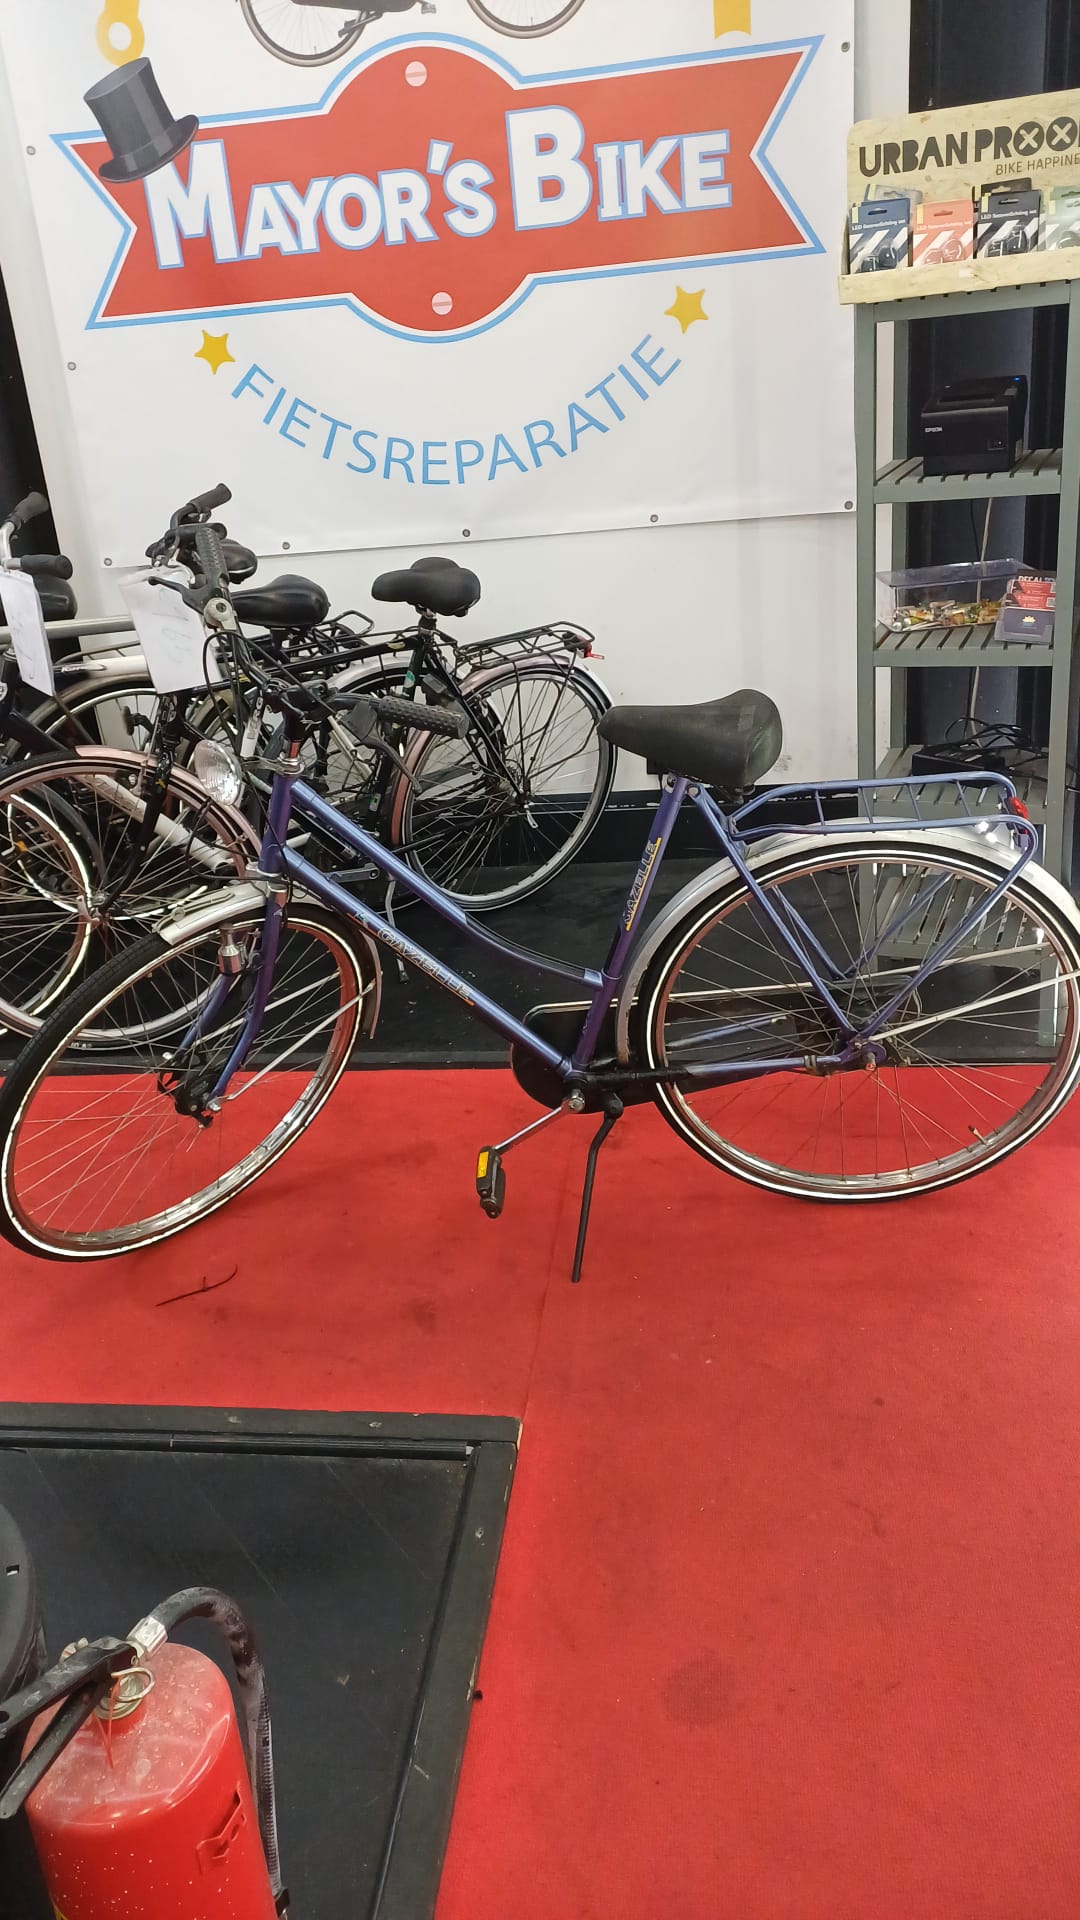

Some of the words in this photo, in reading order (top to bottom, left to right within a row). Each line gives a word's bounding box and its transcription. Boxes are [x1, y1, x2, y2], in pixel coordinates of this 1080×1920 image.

[859, 131, 968, 177] URBAN
[974, 116, 1080, 162] PROO
[995, 161, 1022, 176] BIKE
[144, 139, 496, 269] MAYOR'S
[505, 104, 732, 231] BIKE
[231, 334, 682, 485] FIETSREPARATIE
[623, 840, 657, 924] GAZELLE
[376, 927, 474, 999] GAZELLE
